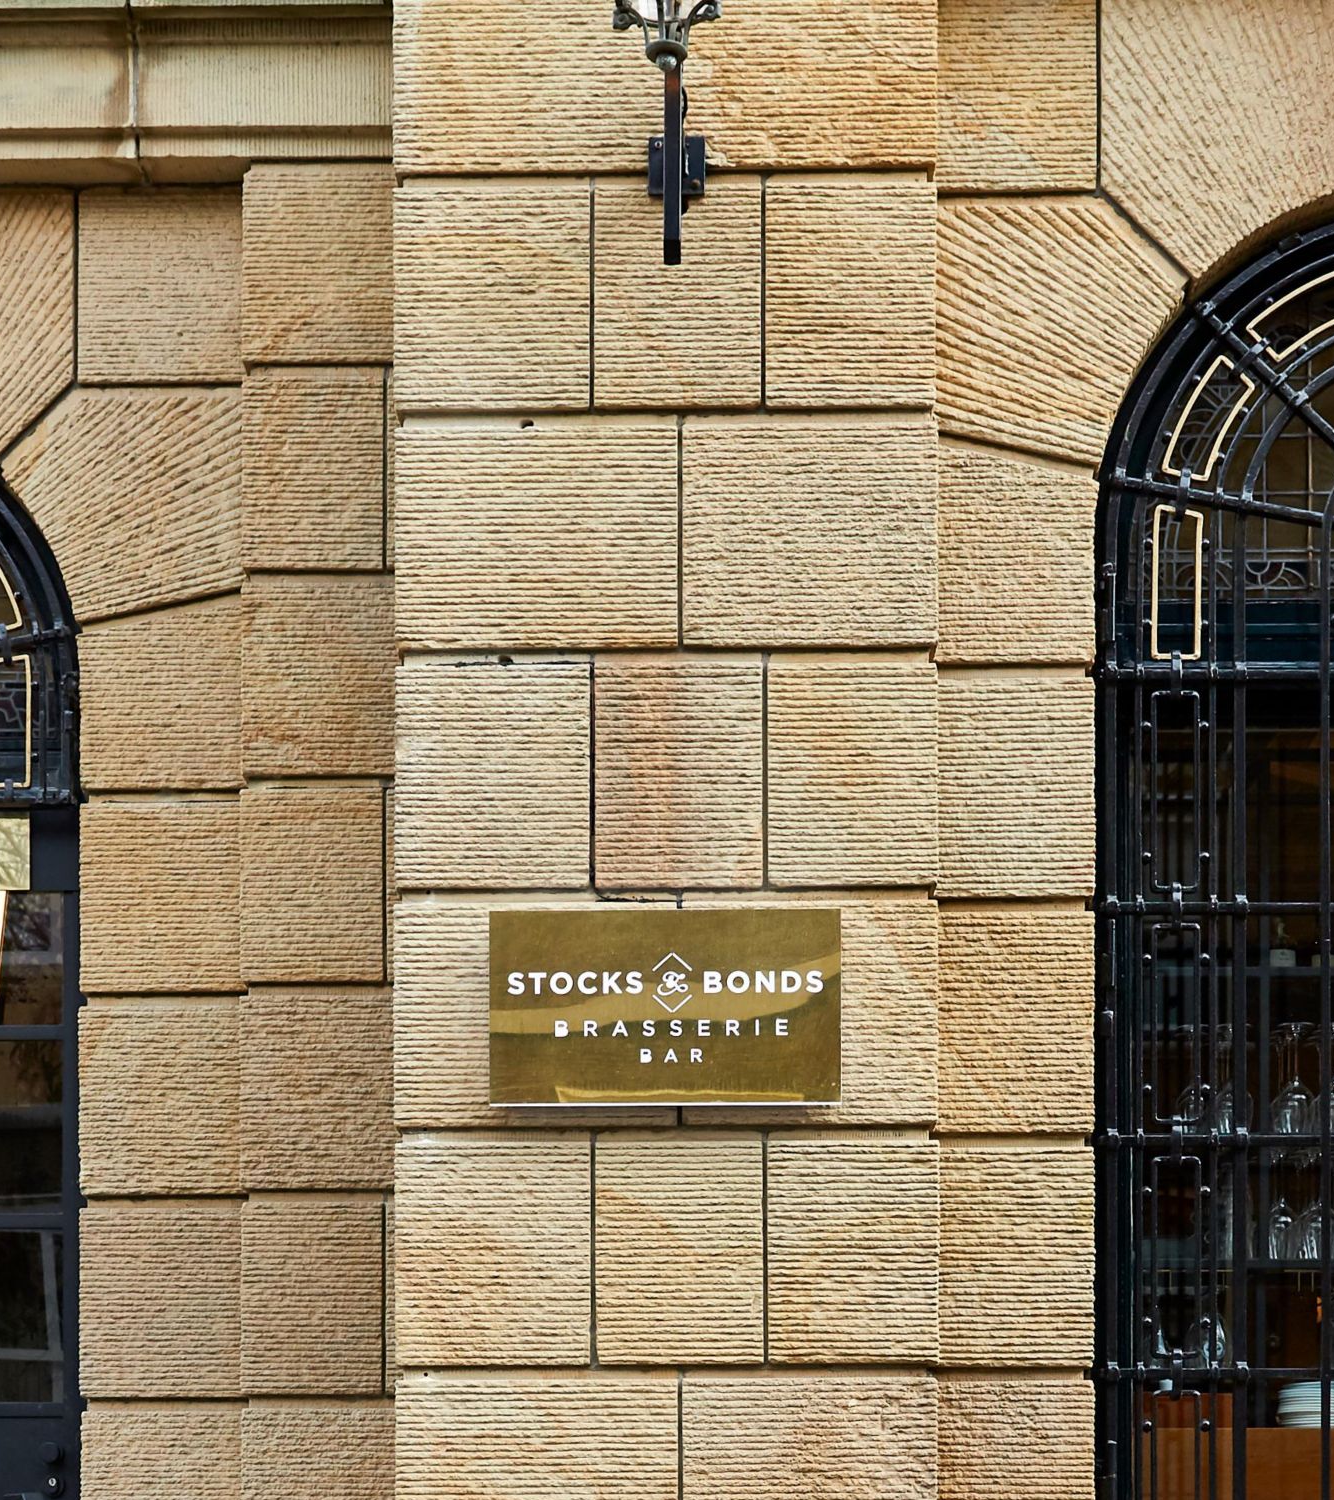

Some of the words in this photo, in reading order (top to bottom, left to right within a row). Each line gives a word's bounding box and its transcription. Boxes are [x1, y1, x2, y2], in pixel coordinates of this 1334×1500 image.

[507, 971, 644, 995] STOCKS
[656, 971, 690, 996] &
[703, 970, 824, 994] BONDS
[554, 1019, 789, 1037] BRASSERIE
[640, 1048, 703, 1063] BAR
